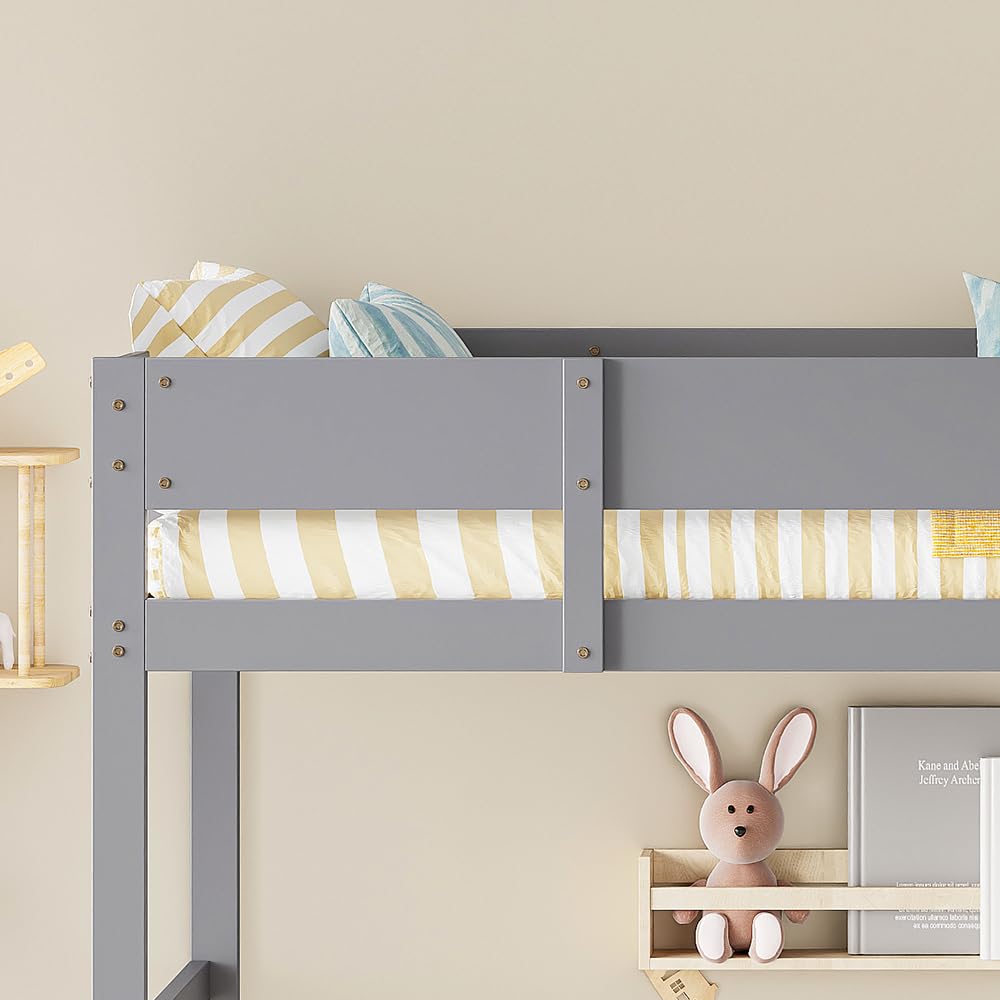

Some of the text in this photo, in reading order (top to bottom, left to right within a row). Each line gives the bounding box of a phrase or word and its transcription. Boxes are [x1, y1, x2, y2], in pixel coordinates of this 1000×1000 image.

[918, 759, 980, 771] Kane and Abe
[919, 774, 949, 788] Jeffrey
